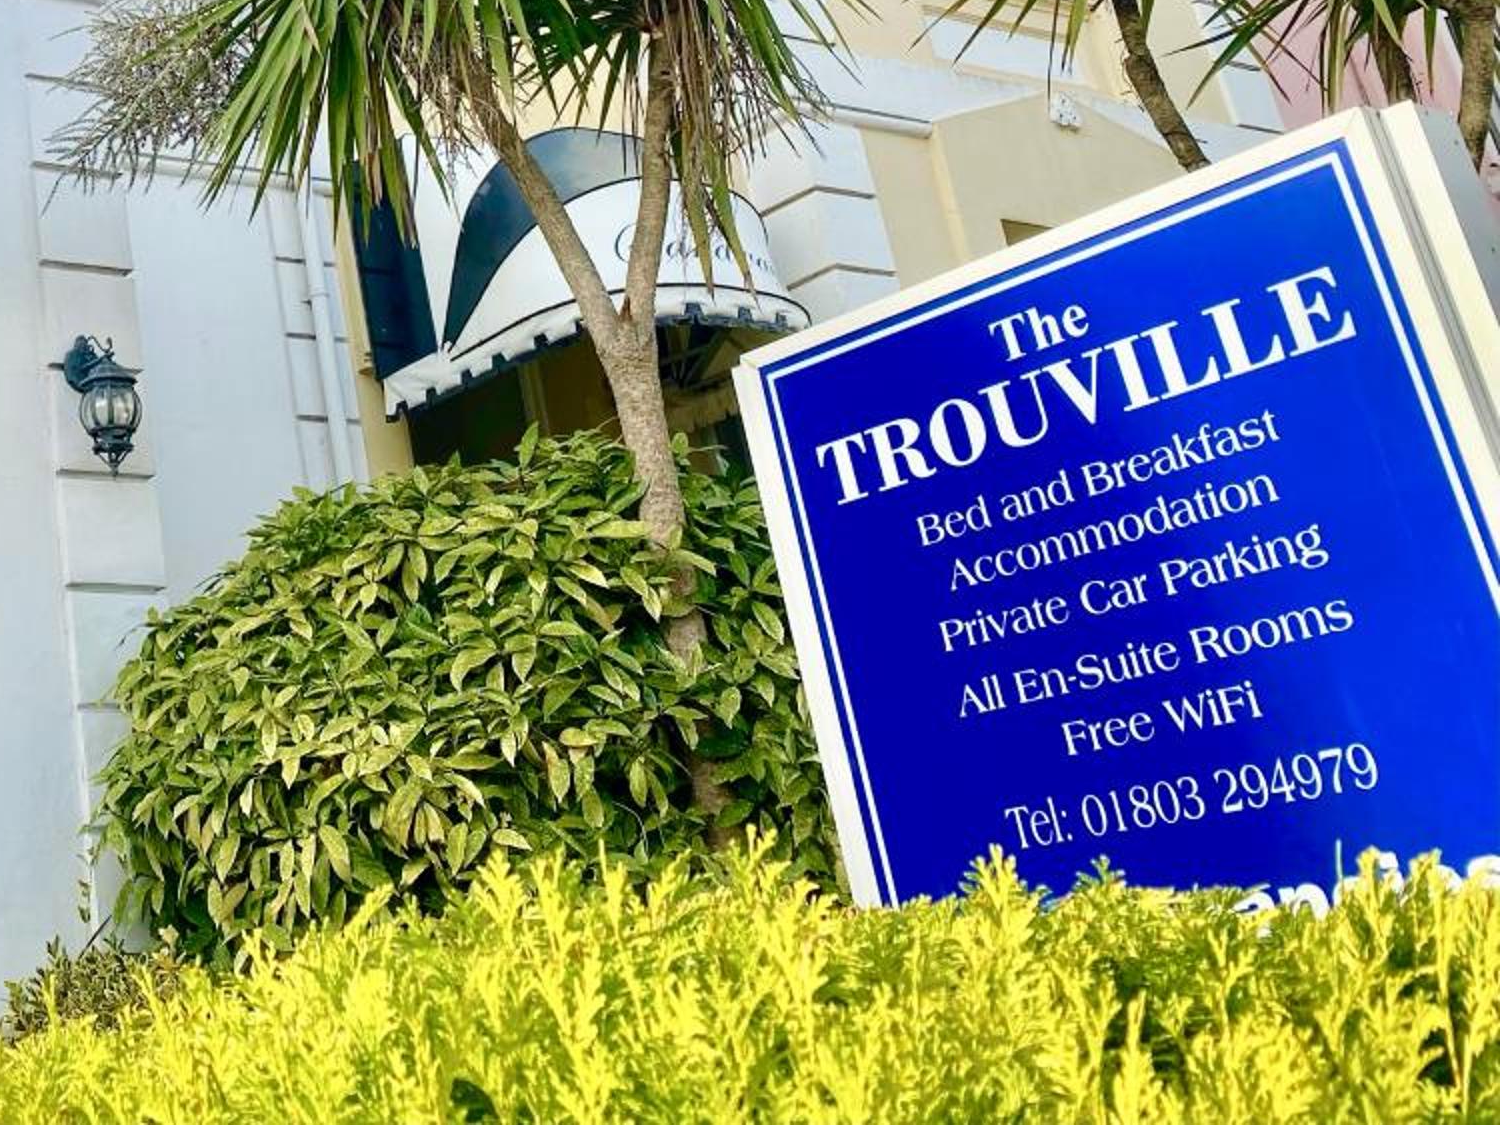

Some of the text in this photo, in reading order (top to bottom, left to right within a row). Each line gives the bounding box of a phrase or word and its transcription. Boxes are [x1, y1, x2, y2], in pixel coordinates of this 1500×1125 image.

[815, 266, 1357, 506] TROUVILLE
[988, 305, 1088, 362] The
[917, 411, 1280, 546] Bed and Breakfast
[952, 475, 1280, 591] Accommodation
[940, 524, 1329, 652] Private Car Parking
[960, 601, 1354, 718] All En-Suite Rooms
[1062, 682, 1263, 756] Free WiFi
[1005, 744, 1378, 849] Tel: 01803 294979
